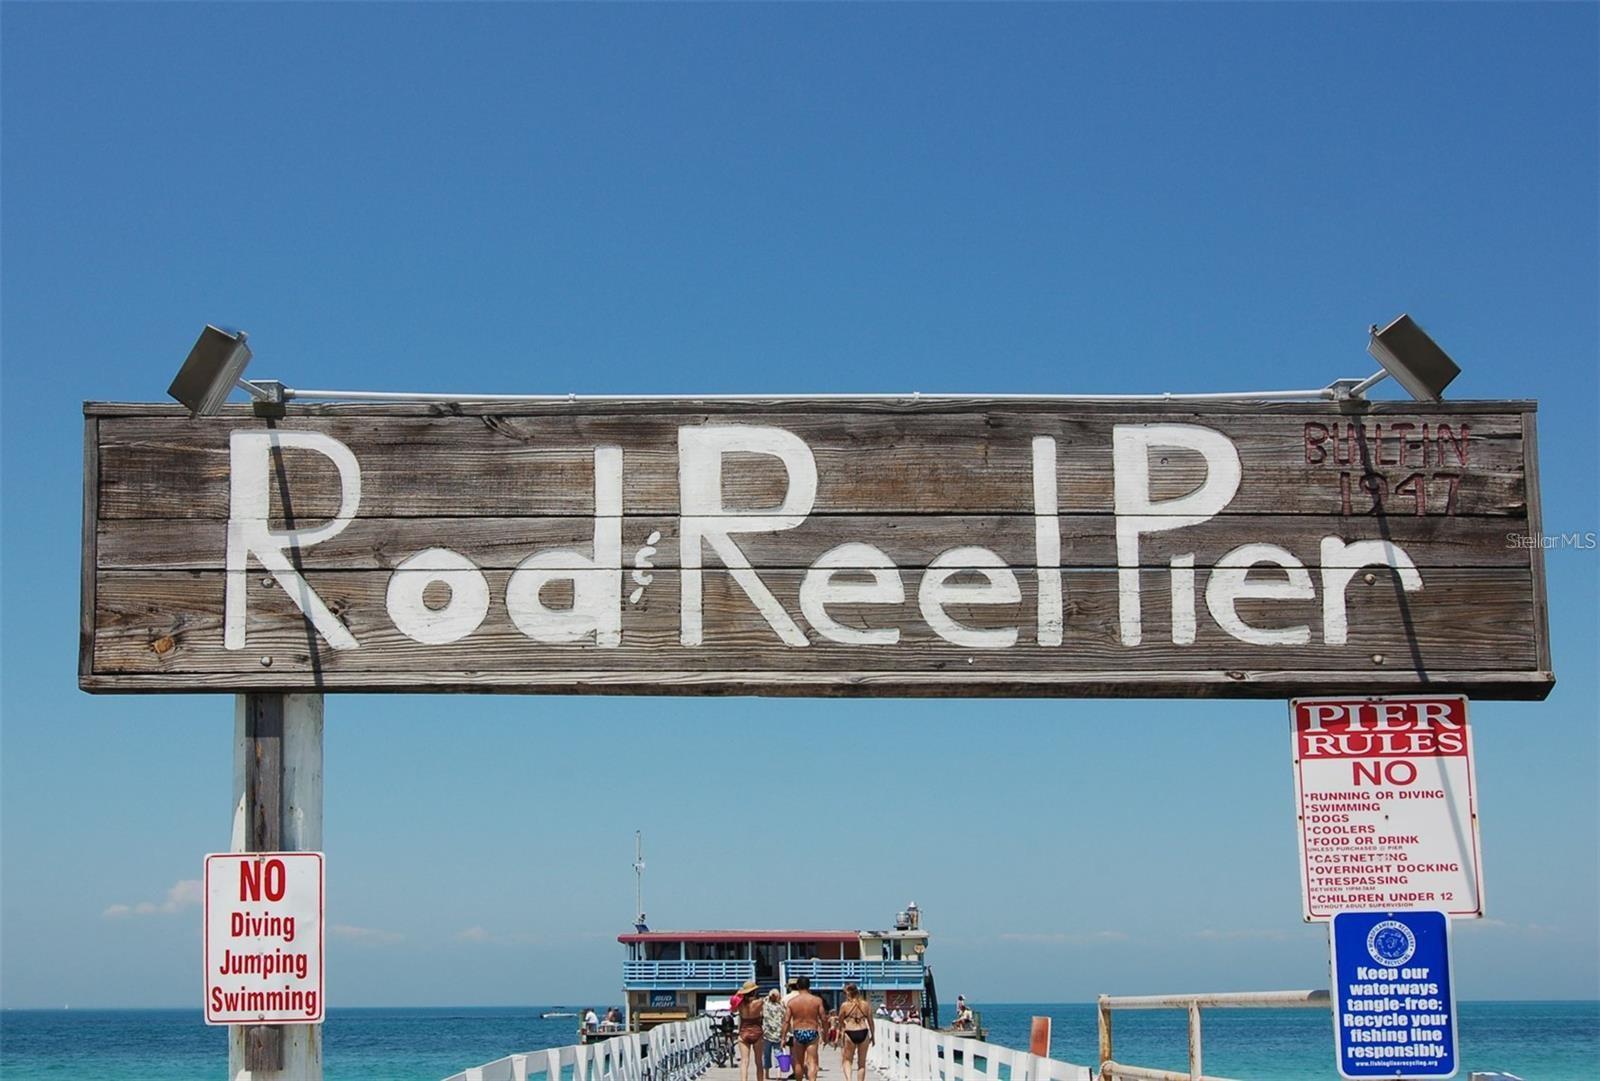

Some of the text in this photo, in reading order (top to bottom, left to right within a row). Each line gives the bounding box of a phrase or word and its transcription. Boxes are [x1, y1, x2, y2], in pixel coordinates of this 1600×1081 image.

[1340, 471, 1460, 517] 1947
[224, 429, 624, 650] Rod
[678, 424, 1064, 649] Reel
[1112, 423, 1423, 648] Pier
[1302, 703, 1462, 733] PIER
[1304, 732, 1463, 755] RULES
[1352, 760, 1418, 786] NO
[1375, 791, 1394, 800] OR
[1399, 790, 1445, 799] DIVING
[1354, 836, 1373, 845] OR
[1378, 835, 1420, 844] DRINK
[1397, 863, 1459, 873] DOCKING
[240, 859, 286, 902] NO
[1389, 893, 1434, 902] UNDER
[1440, 892, 1453, 901] 12
[231, 911, 295, 942] Diving
[220, 948, 307, 980] Jumping
[1357, 967, 1429, 980] Keep our
[1350, 983, 1438, 996] waterways
[212, 985, 317, 1016] Swimming
[1347, 997, 1442, 1012] tangle-free;
[1344, 1013, 1448, 1027] Recycle your
[1351, 1029, 1442, 1043] fishing line
[1348, 1044, 1448, 1059] responsibly.
